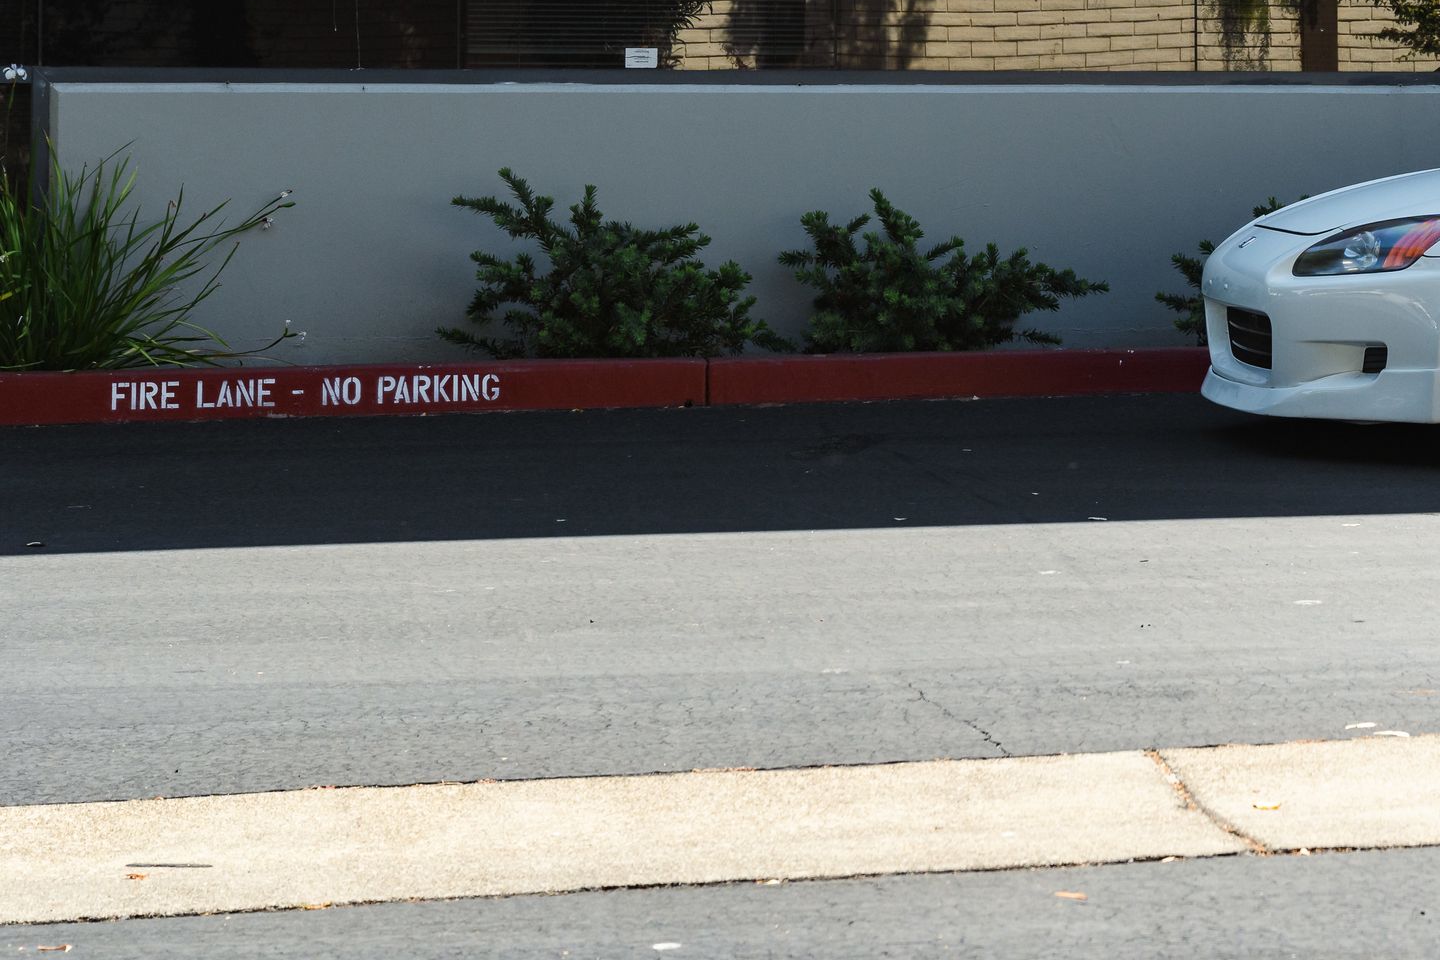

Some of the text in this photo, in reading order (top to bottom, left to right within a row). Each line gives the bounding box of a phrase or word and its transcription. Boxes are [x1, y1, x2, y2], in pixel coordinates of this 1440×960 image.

[111, 380, 180, 411] FIRE
[196, 378, 276, 408] LANE
[321, 376, 362, 406] NO
[377, 373, 501, 405] PARKING
